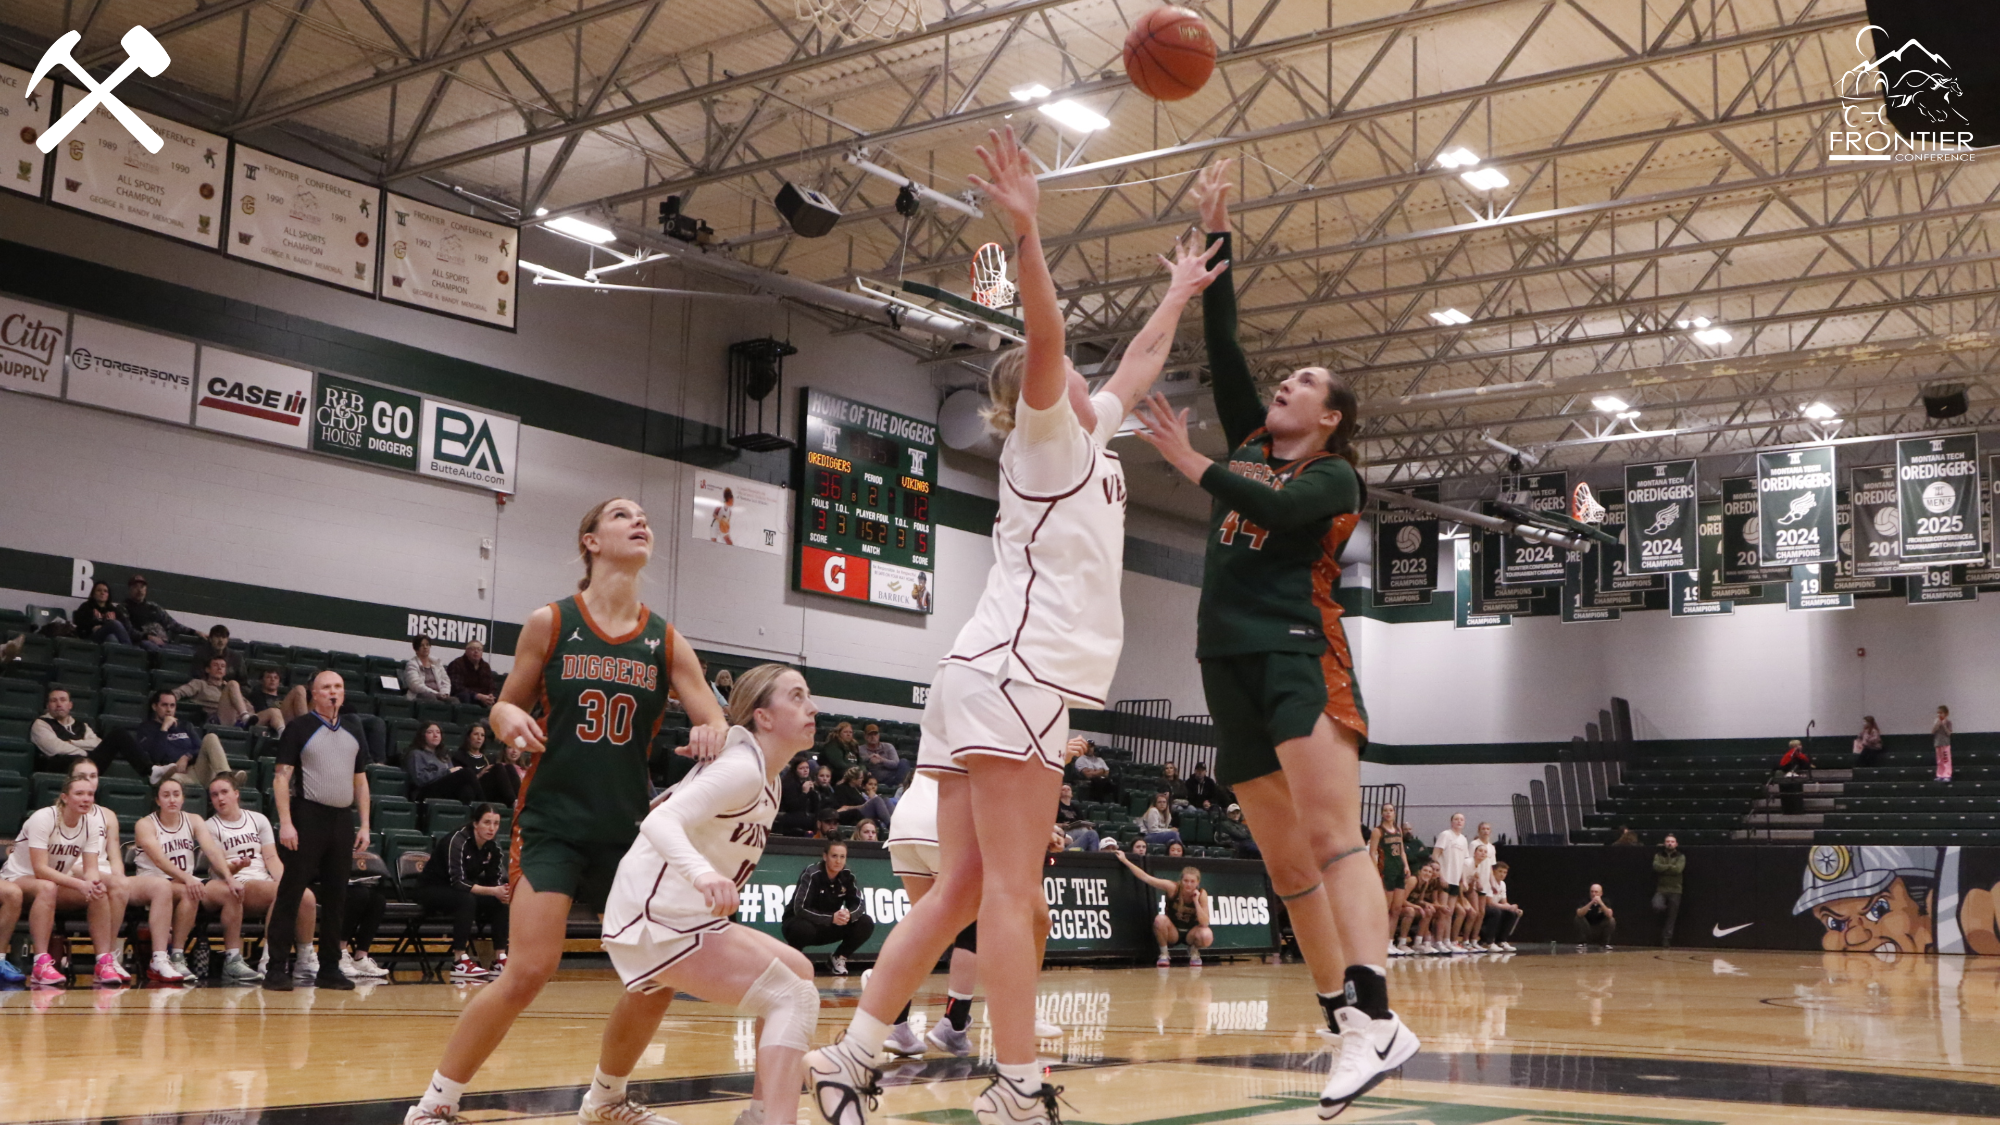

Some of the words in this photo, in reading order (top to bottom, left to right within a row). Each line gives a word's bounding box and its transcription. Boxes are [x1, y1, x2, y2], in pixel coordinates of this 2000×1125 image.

[98, 138, 118, 151] 1989
[171, 162, 190, 174] 1990
[118, 174, 132, 186] ALL
[134, 179, 165, 196] SPORTS
[264, 164, 299, 182] FRONTIER
[305, 178, 352, 198] CONFERENCE
[116, 186, 161, 207] CHAMPION
[266, 193, 284, 205] 1990
[89, 194, 116, 209] GEORGE
[128, 206, 150, 218] BANDY
[152, 213, 185, 229] MEMORIAL
[331, 212, 346, 224] 1991
[414, 210, 445, 226] FRONTIER
[450, 222, 494, 239] CONFERENCE
[284, 227, 297, 237] ALL
[298, 230, 326, 245] SPORTS
[415, 238, 431, 248] 1992
[282, 238, 323, 256] CHAMPION
[261, 247, 284, 258] GEORGE
[293, 256, 313, 266] BANDY
[315, 261, 344, 275] MEMORIAL
[474, 254, 488, 264] 1993
[432, 268, 444, 278] ALL
[446, 272, 470, 284] SPORTS
[412, 288, 433, 299] GEORGE
[432, 280, 468, 294] CHAMPION
[1, 313, 63, 366] City
[93, 357, 189, 386] TORGERSON'S
[95, 368, 189, 392] EQUIPMENT
[207, 377, 282, 409] CASE
[325, 387, 364, 413] RIB
[316, 406, 368, 433] CHOP
[372, 400, 414, 439] GO
[812, 393, 848, 420] HOME
[849, 404, 865, 424] OF
[866, 409, 889, 432] THE
[889, 416, 936, 445] DIGGERS
[321, 426, 362, 448] HOUSE
[368, 437, 413, 458] DIGGERS
[808, 451, 852, 473] OREDIGGERS
[1911, 455, 1945, 463] MONTANA
[430, 461, 505, 486] ButteAuto.com
[864, 472, 883, 485] PERIOD
[1770, 466, 1803, 476] MONTANA
[1804, 464, 1821, 472] TECH
[1901, 460, 1976, 480] OREDIGGERS
[821, 472, 841, 499] 36
[901, 476, 929, 493] VIKINGS
[1637, 480, 1668, 488] MONTANA
[1669, 477, 1684, 485] TECH
[1761, 472, 1832, 492] OREDIGGERS
[1864, 481, 1895, 489] MONTANA
[869, 486, 878, 506] 2
[1628, 485, 1695, 503] OREDIGGERS
[1926, 498, 1952, 507] MEN'S
[811, 497, 829, 509] FOULS
[835, 503, 850, 514] T.O.L.
[914, 497, 928, 520] 12
[818, 510, 826, 530] 3
[856, 508, 876, 521] PLAYER
[876, 512, 889, 523] FOUL
[895, 517, 908, 528] T.O.L.
[839, 515, 845, 534] 3
[861, 521, 873, 540] 15
[879, 525, 887, 543] 2
[914, 522, 929, 533] FOULS
[1917, 515, 1963, 535] 2025
[810, 533, 828, 544] SCORE
[898, 529, 905, 547] 3
[919, 534, 926, 552] 5
[1776, 527, 1820, 546] 2024
[862, 544, 880, 555] MATCH
[1516, 546, 1554, 563] 2024
[1642, 538, 1683, 556] 2024
[1776, 549, 1821, 559] CHAMPIONS
[1869, 542, 1899, 557] 201
[912, 555, 928, 566] SCORE
[1391, 558, 1427, 574] 2023
[1641, 559, 1684, 569] CHAMPIONS
[71, 559, 94, 598] B
[824, 556, 846, 592] G
[1390, 578, 1427, 587] CHAMPIONS
[1921, 571, 1950, 587] 198
[1966, 573, 2000, 581] CHAMPIO
[1495, 587, 1532, 596] CHAMPIONS
[1613, 579, 1652, 588] CHAMPIONS
[1834, 580, 1876, 590] CHAMPIONS
[878, 591, 910, 604] BARRICK
[1384, 594, 1420, 603] CHAMPIONS
[1712, 588, 1750, 597] CHAMPIONS
[1921, 591, 1963, 600] CHAMPIONS
[1483, 603, 1518, 611] CHAMPIONS
[1683, 604, 1720, 613] CHAMPIONS
[1801, 598, 1840, 607] CHAMPIONS
[1467, 617, 1501, 626] CHAMPIONS
[1573, 611, 1608, 619] CHAMPIONS
[407, 614, 487, 645] RESERVED
[561, 655, 658, 691] DIGGERS
[576, 689, 637, 745] 30
[224, 833, 261, 851] VIKINGS
[1043, 877, 1067, 906] OF
[1071, 878, 1109, 906] THE
